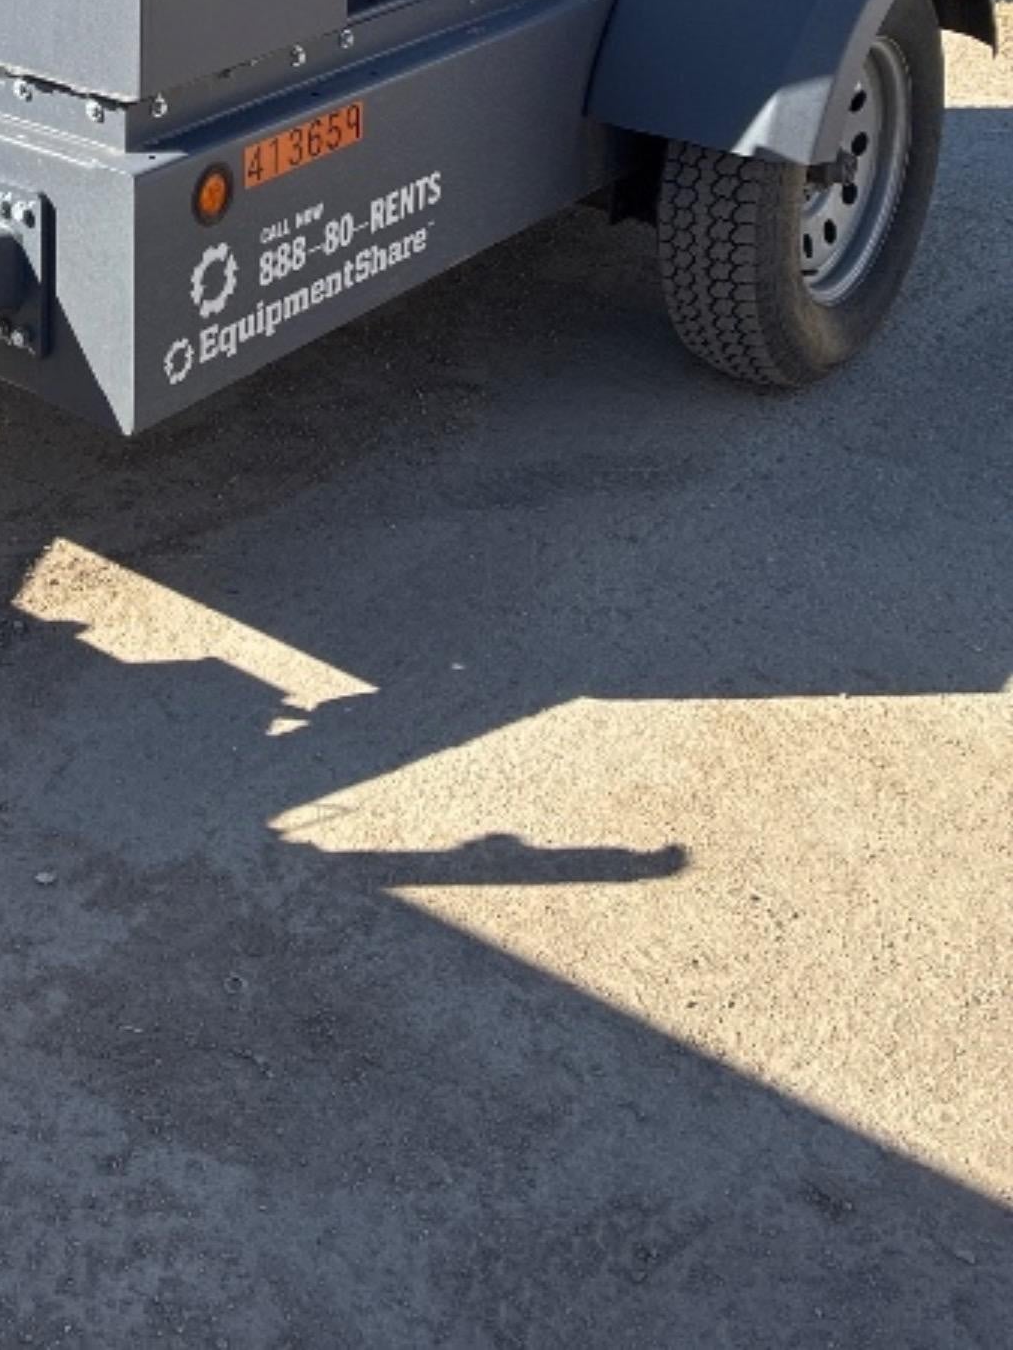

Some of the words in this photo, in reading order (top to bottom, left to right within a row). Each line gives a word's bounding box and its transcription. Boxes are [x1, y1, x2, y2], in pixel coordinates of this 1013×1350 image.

[246, 101, 363, 182] 413659
[258, 170, 442, 287] 888-80-RENTS
[198, 226, 428, 364] EquipmentShare
